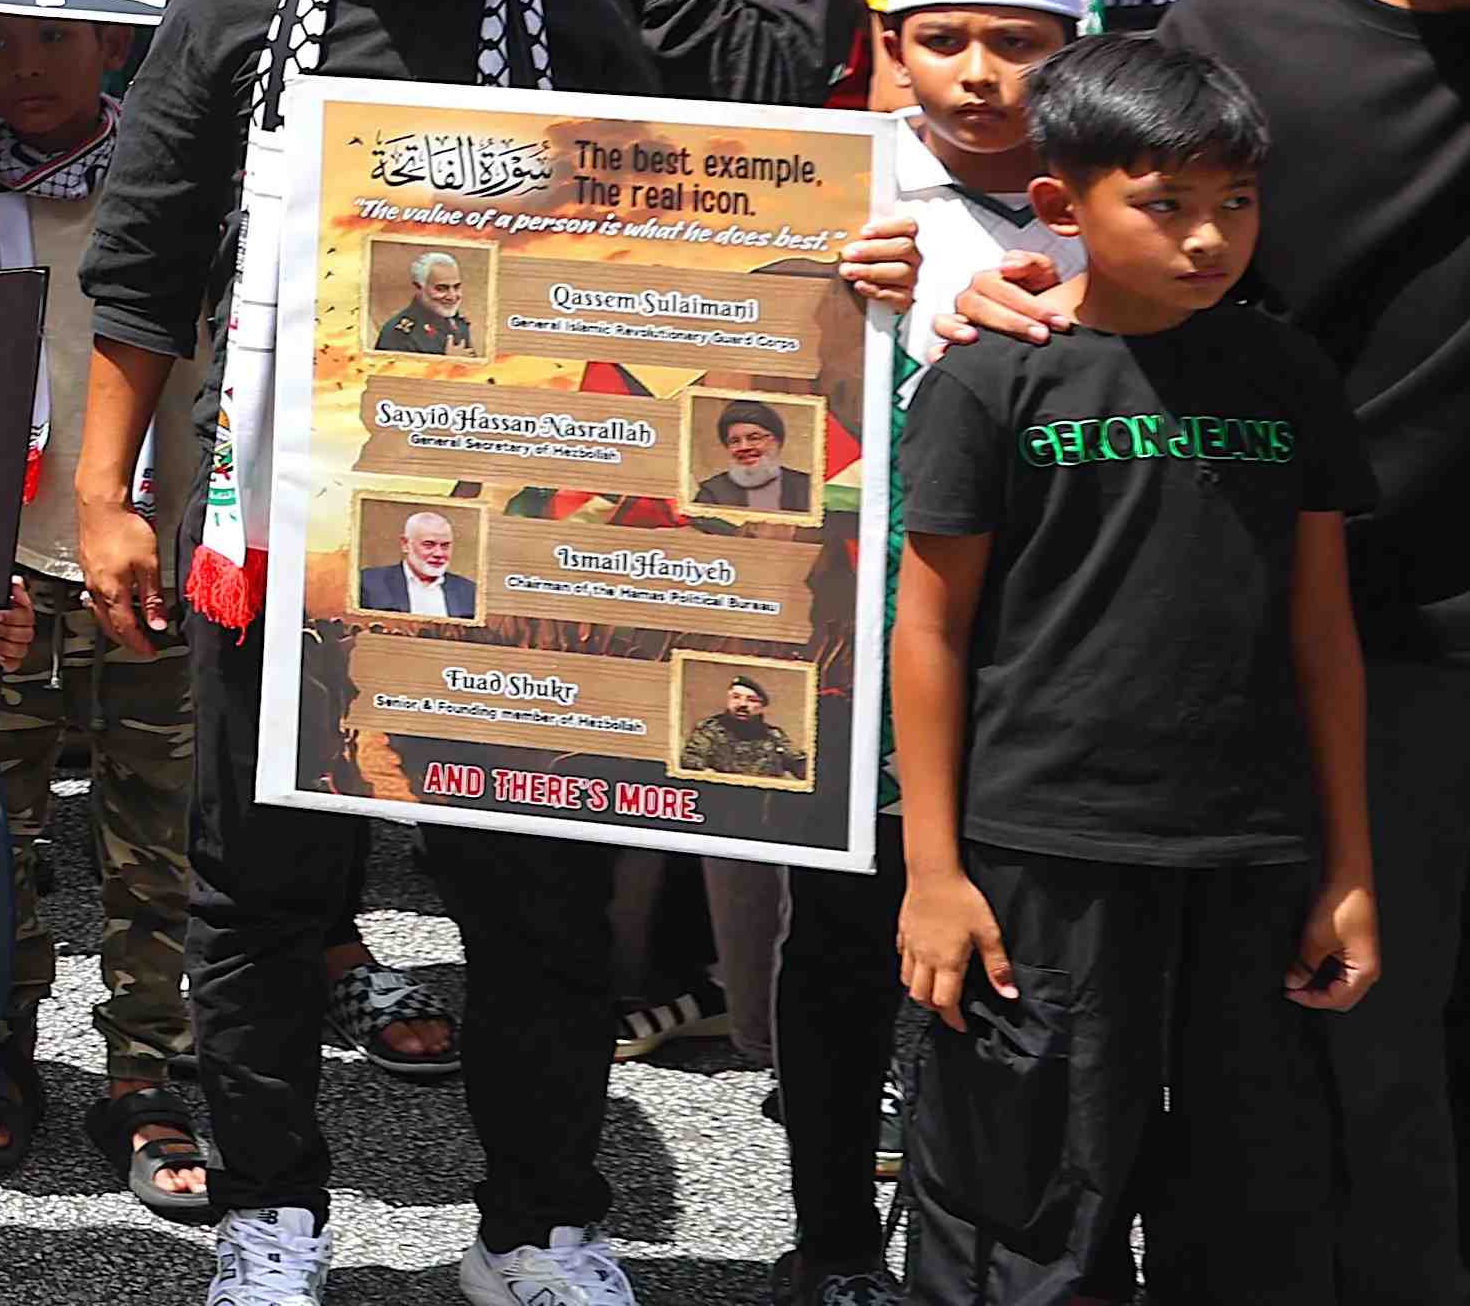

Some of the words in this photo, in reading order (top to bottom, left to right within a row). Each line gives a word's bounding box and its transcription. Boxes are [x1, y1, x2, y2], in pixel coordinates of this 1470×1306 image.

[574, 140, 622, 172] The
[633, 143, 693, 176] best
[574, 175, 621, 206] The
[631, 183, 684, 211] real
[693, 183, 757, 216] icon.
[402, 203, 465, 225] value
[466, 208, 494, 229] of
[495, 216, 510, 229] a
[509, 214, 597, 234] person
[598, 213, 622, 236] is
[623, 217, 685, 239] what
[685, 221, 712, 243] he
[713, 225, 770, 247] does
[552, 286, 636, 310] Qassem
[510, 316, 561, 330] General
[379, 403, 449, 429] Sayyid
[452, 407, 537, 436] Hassan
[541, 416, 653, 445] Nasrallah
[1168, 416, 1295, 464] JEANS
[411, 434, 461, 447] General
[465, 438, 530, 456] Secretary
[507, 576, 572, 592] Chairman
[557, 548, 628, 573] Ismail
[631, 552, 733, 584] Haniyeh
[445, 669, 502, 692] Fuad
[508, 676, 577, 704] Shukr
[376, 695, 418, 710] Senior
[422, 700, 433, 711] &
[437, 701, 497, 720] Founding
[423, 762, 485, 797] AND
[492, 767, 609, 812] THERE'S
[616, 782, 705, 823] MORE.
